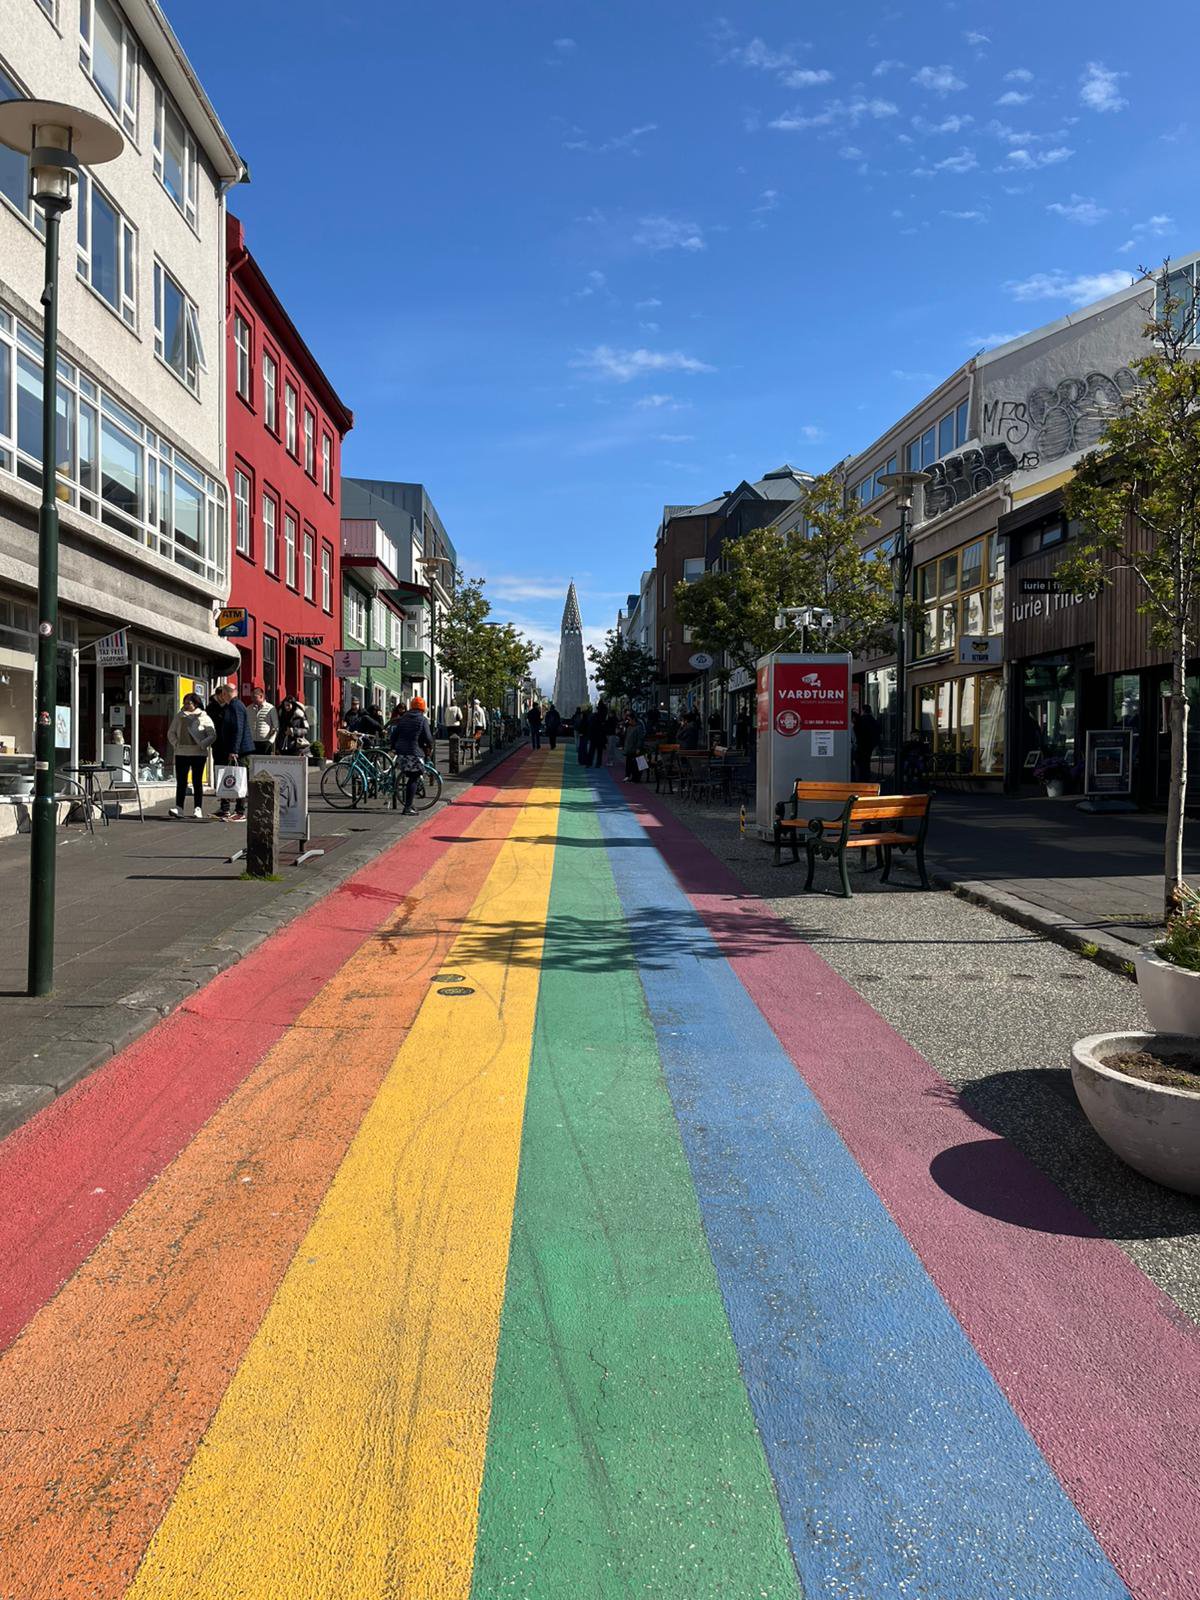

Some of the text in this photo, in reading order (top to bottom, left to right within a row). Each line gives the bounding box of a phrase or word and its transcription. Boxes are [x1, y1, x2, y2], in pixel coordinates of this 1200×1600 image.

[1024, 581, 1045, 590] iurie
[1012, 595, 1042, 623] iurie
[222, 610, 242, 619] ATM
[778, 690, 844, 699] VARÐTURN
